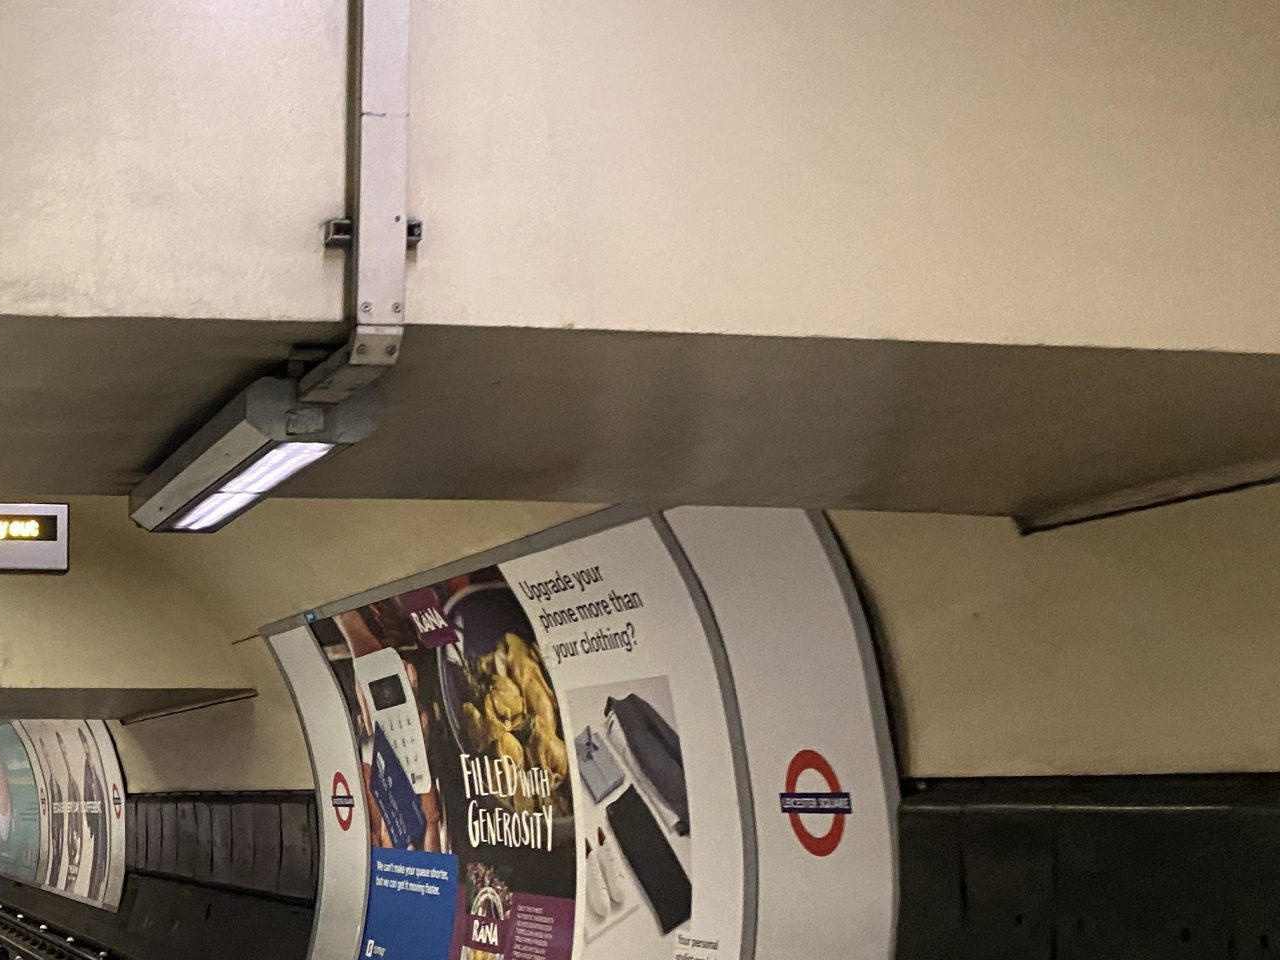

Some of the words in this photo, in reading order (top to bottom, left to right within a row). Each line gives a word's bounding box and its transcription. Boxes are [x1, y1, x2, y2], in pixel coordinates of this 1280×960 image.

[9, 519, 40, 538] out
[518, 570, 574, 602] Upgrade
[572, 565, 603, 592] your
[538, 608, 578, 633] phone
[576, 599, 612, 620] more
[608, 590, 644, 612] than
[552, 640, 579, 664] your
[580, 622, 638, 654] clothing?
[460, 753, 518, 798] FILLED
[520, 767, 551, 798] WITH
[468, 800, 553, 852] GENEROSITY
[678, 934, 691, 946] Your
[691, 938, 719, 950] personal
